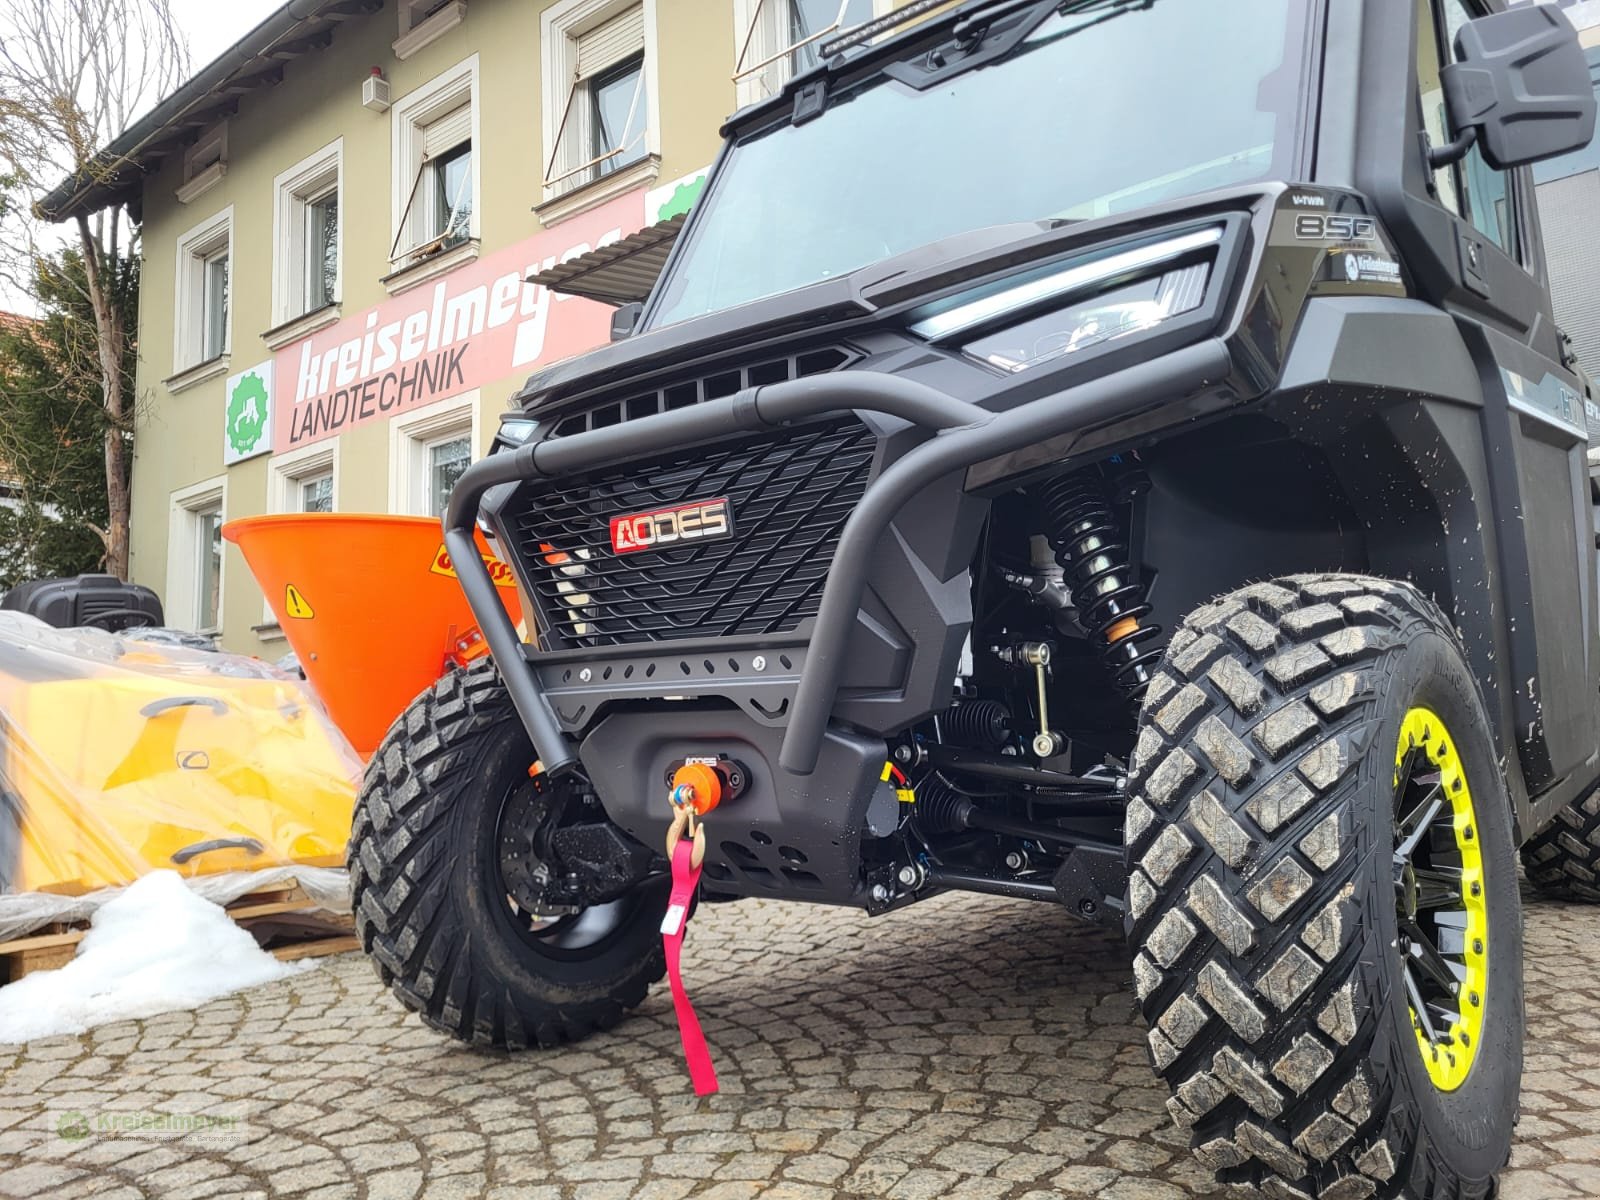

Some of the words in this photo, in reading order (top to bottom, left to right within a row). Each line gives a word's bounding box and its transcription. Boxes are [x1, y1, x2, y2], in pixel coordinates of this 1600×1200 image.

[1292, 195, 1324, 206] V-TWIN
[1294, 213, 1376, 240] 850
[289, 342, 470, 444] LANDTECHNIK
[616, 502, 727, 550] AODES
